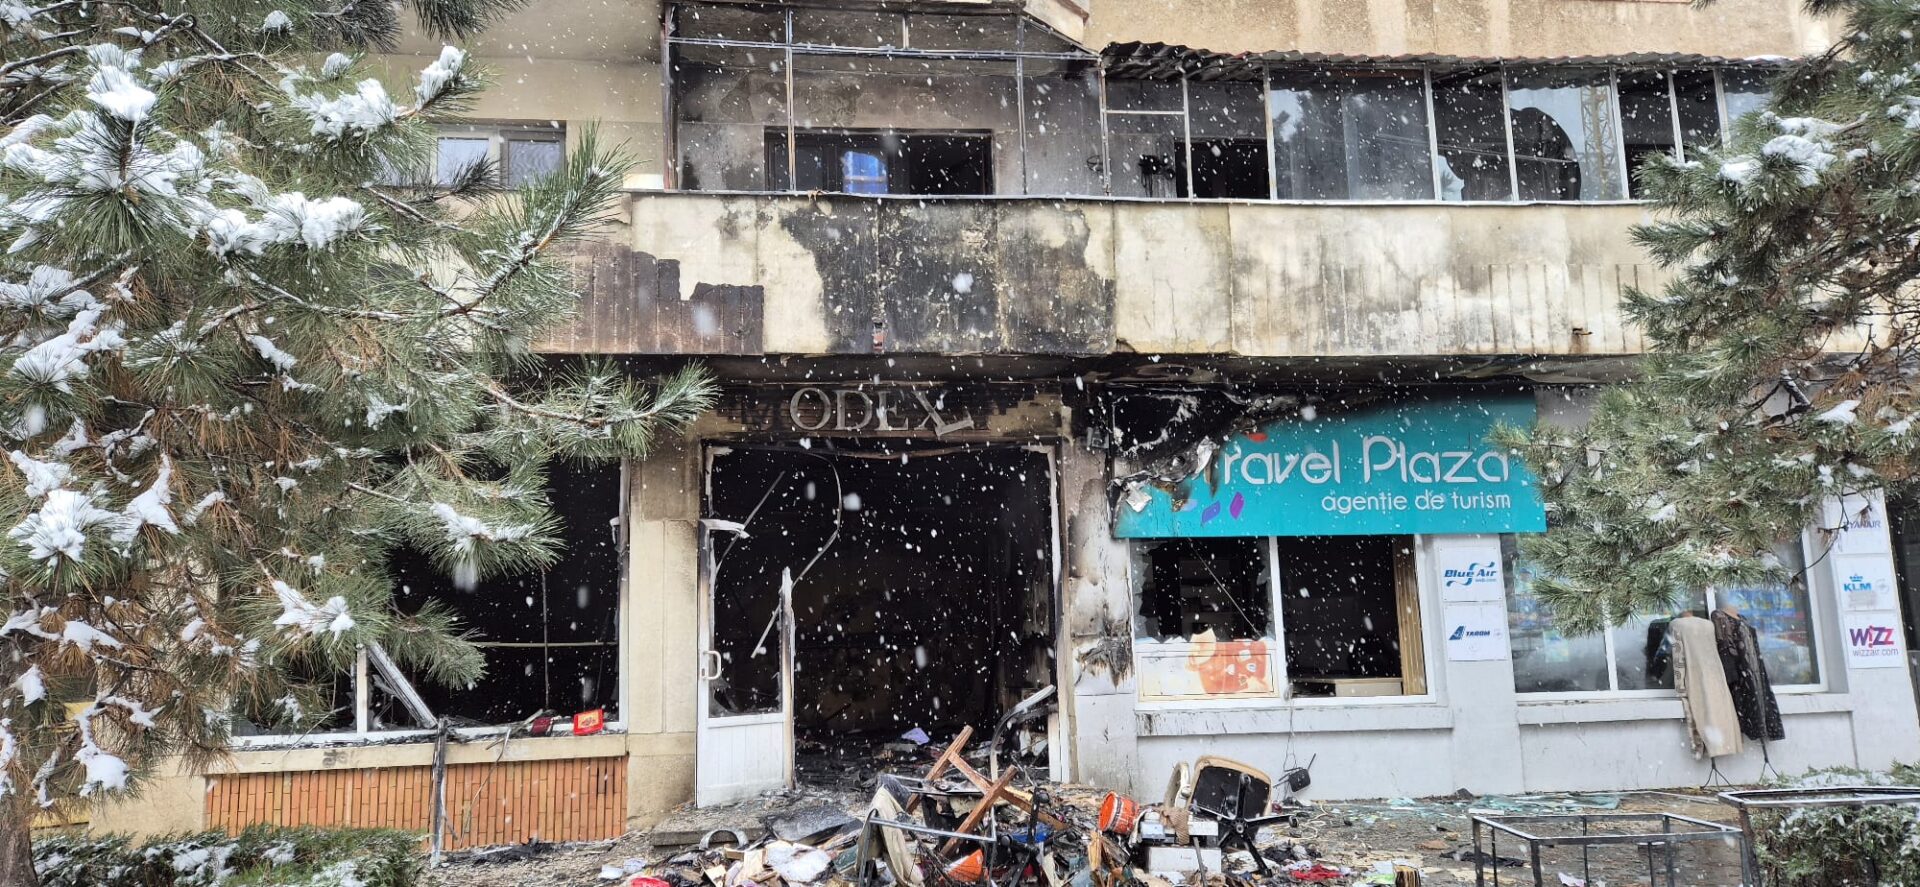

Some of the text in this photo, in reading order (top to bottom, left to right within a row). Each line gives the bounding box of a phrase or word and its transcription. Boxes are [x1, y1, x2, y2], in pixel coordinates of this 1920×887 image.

[1362, 435, 1509, 484] Plaza
[1414, 489, 1445, 510] de
[1450, 491, 1511, 510] turism
[1444, 568, 1497, 578] Blue Air
[1843, 582, 1872, 592] KLM
[1852, 648, 1899, 657] wizzair.com
